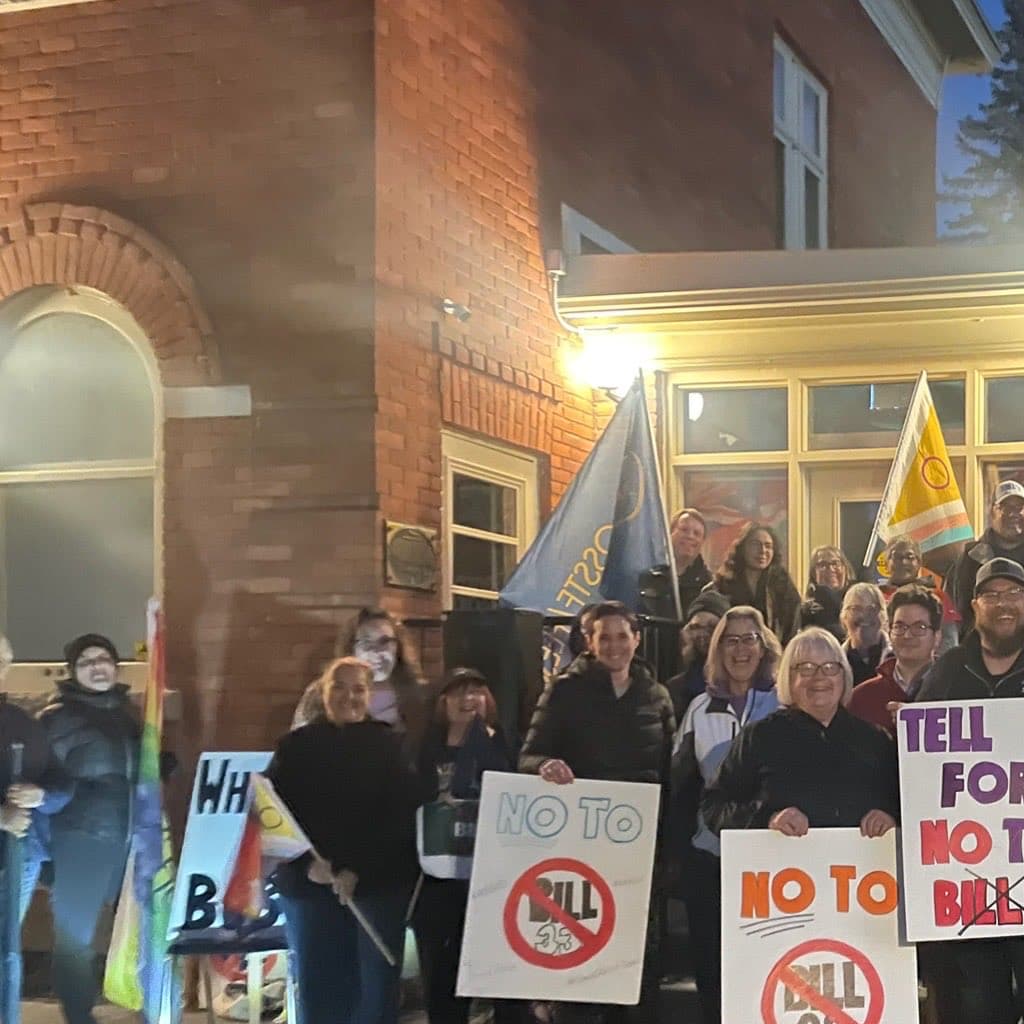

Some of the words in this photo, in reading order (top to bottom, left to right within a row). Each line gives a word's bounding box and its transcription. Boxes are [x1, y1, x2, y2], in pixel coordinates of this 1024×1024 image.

[900, 706, 992, 753] TELL
[496, 792, 568, 838] NO
[579, 797, 643, 843] TO
[920, 820, 992, 865] NO
[529, 878, 598, 923] BILL
[740, 867, 816, 918] NO
[830, 865, 898, 915] TO
[933, 877, 1023, 927] BILL
